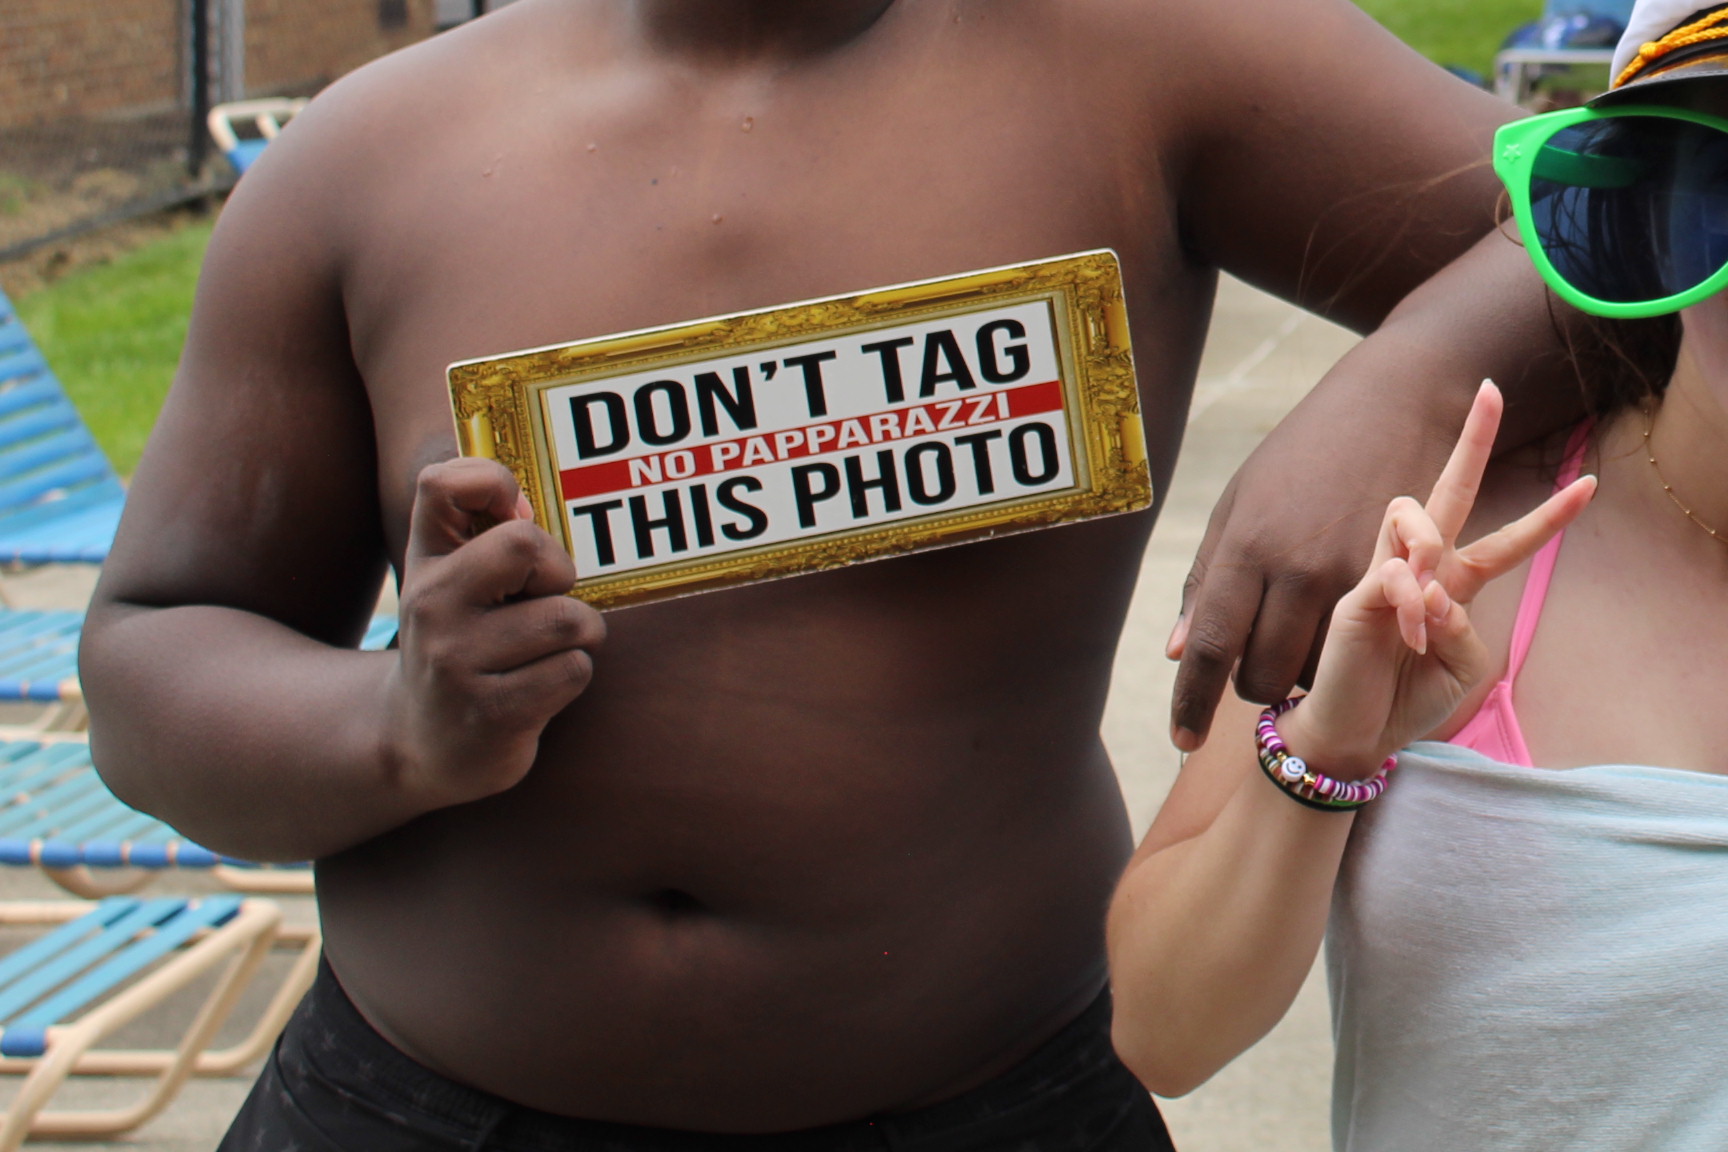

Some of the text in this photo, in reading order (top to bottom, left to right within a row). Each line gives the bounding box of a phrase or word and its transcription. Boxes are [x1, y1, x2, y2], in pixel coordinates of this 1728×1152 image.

[568, 317, 1032, 461] DON'T TAG
[628, 391, 1011, 487] NO PAPPARAZZI
[572, 421, 1061, 567] THIS PHOTO
